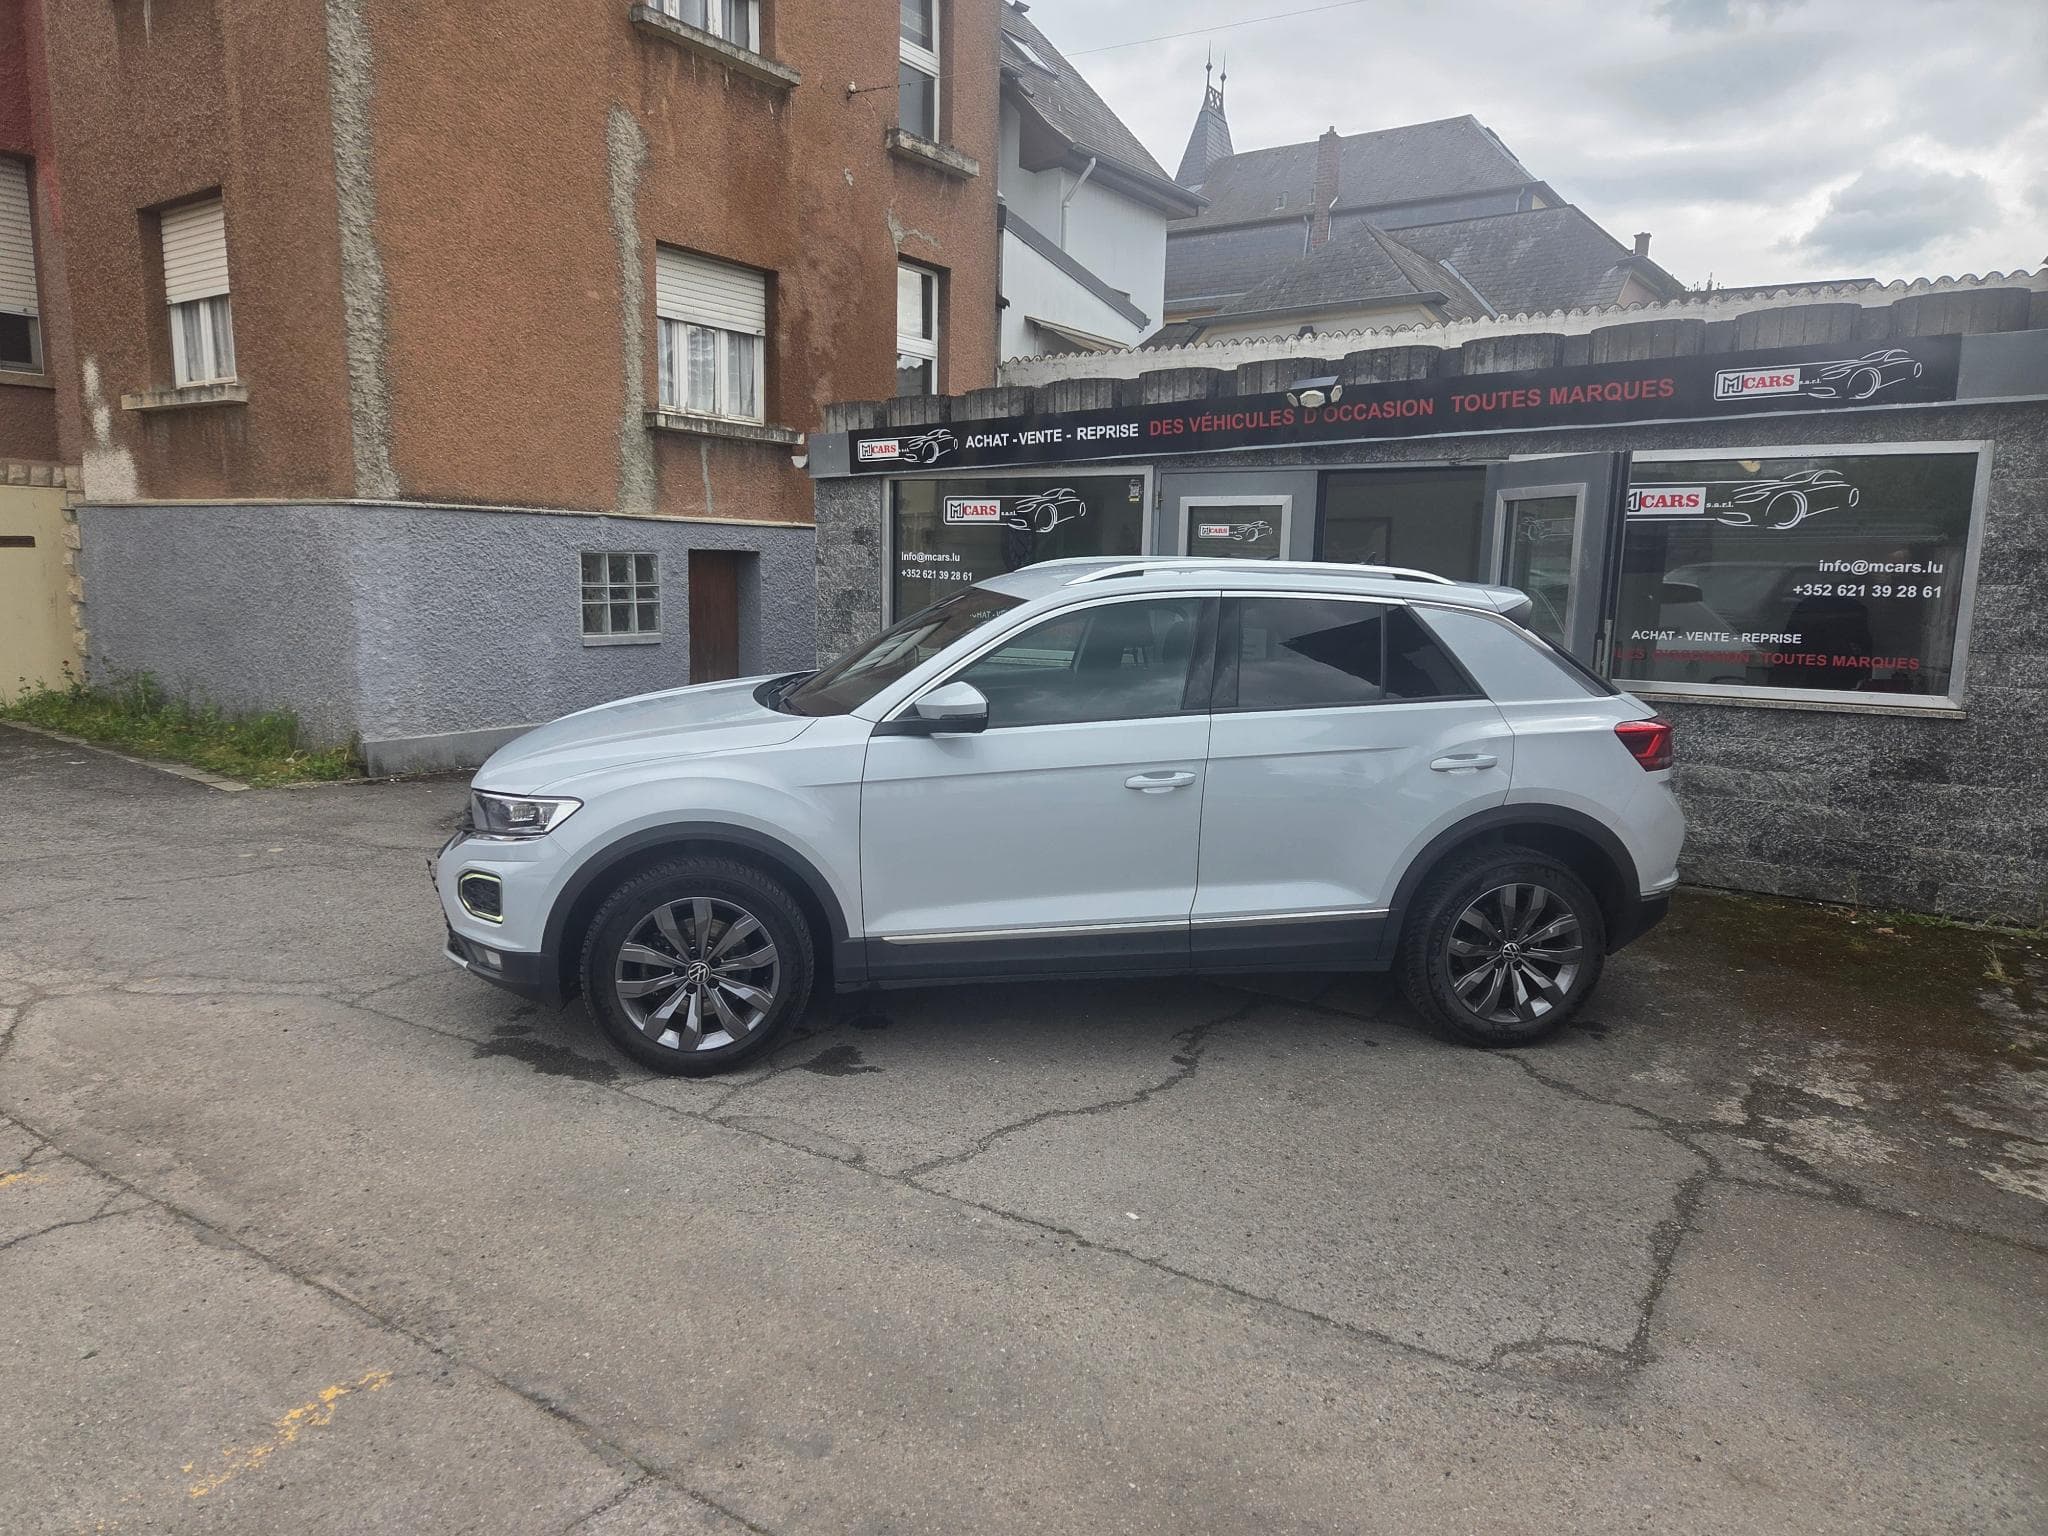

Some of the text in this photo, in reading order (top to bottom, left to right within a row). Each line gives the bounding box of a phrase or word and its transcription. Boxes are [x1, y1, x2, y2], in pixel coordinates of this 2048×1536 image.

[965, 433, 1010, 449] ACHAT
[1076, 423, 1139, 441] REPRISE
[1150, 419, 1184, 436] DES
[1189, 408, 1295, 433] VÉHICULES
[1451, 388, 1541, 413] TOUTES
[1550, 378, 1675, 405] MARQUES
[1818, 560, 1944, 575] info@mcars.lu
[901, 569, 973, 582] +352 621 39 28 61
[1792, 584, 1942, 598] +352 621 39 28 61
[1631, 630, 1675, 640] ACHAT
[1686, 632, 1729, 642] VENTE
[1741, 633, 1802, 644] REPRISE
[1761, 653, 1827, 666] TOUTES
[1832, 655, 1920, 670] MARQUES
